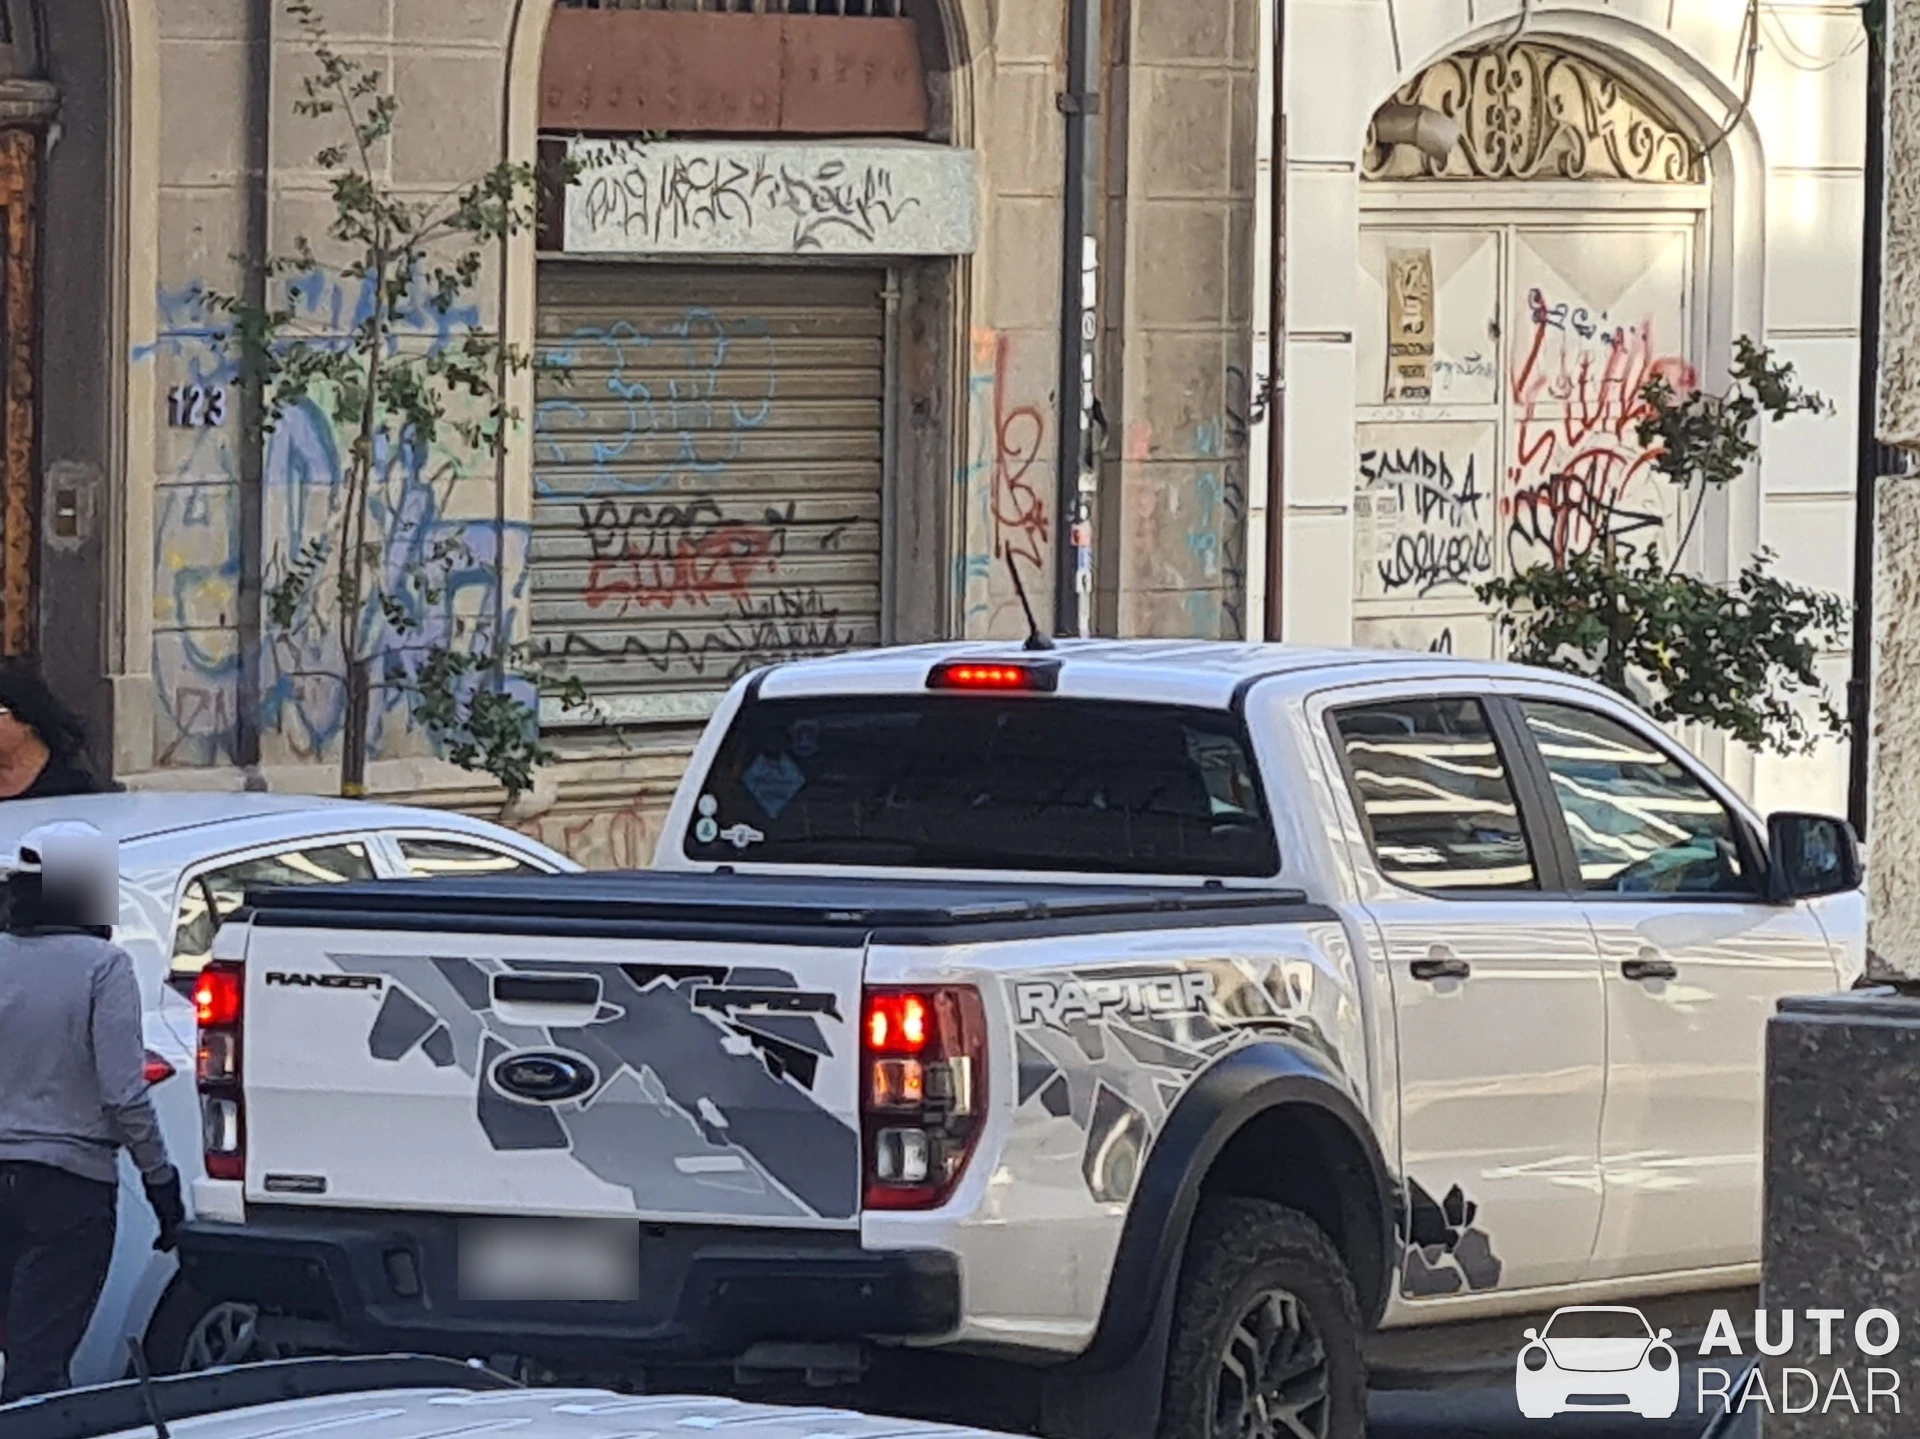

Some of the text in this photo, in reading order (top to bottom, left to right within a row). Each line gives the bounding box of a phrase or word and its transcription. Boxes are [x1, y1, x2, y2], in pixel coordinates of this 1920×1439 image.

[169, 384, 225, 427] 123
[266, 972, 382, 990] RANGER
[1016, 971, 1220, 1030] RAPTOR
